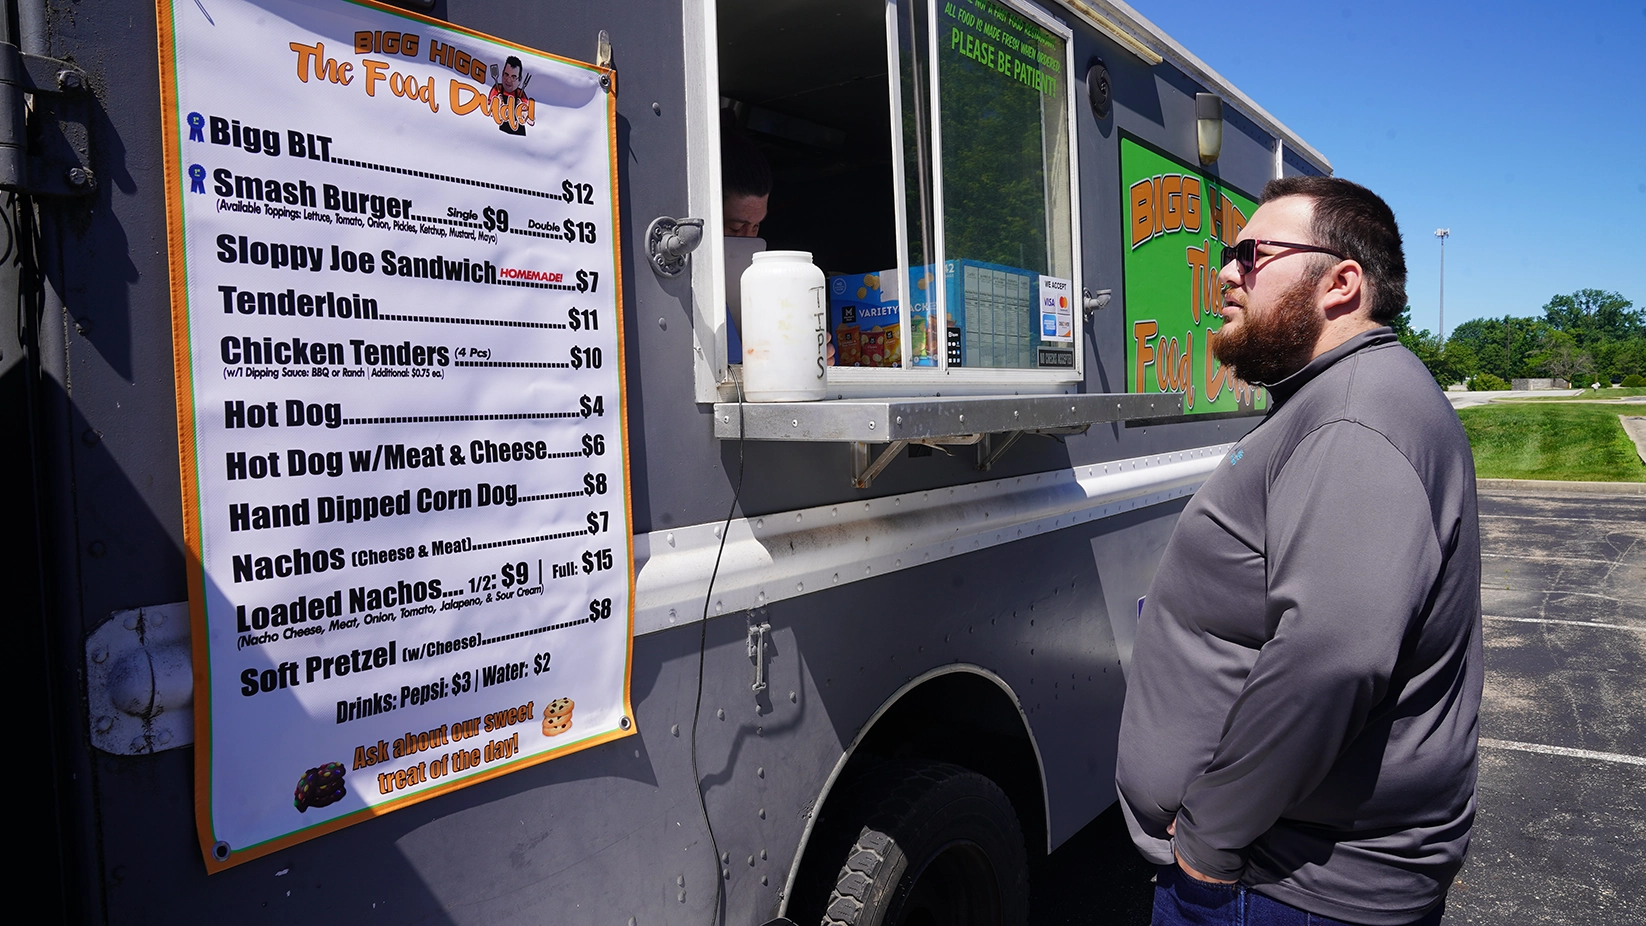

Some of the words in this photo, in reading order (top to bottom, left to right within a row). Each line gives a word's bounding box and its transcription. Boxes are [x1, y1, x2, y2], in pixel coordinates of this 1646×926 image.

[354, 30, 420, 56] BIGG
[430, 39, 487, 84] HIGG
[944, 2, 956, 18] ALL
[958, 8, 975, 27] FOOD
[976, 18, 983, 32] IS
[984, 23, 1002, 42] MADE
[1002, 31, 1020, 52] FRESH
[1020, 42, 1036, 60] WHEN
[289, 42, 354, 86] The
[362, 59, 439, 113] Food
[450, 79, 536, 130] Dude!
[952, 27, 994, 69] PLEASE
[998, 50, 1011, 76] BE
[1014, 59, 1057, 98] PATIENT!
[210, 116, 280, 156] Bigg
[288, 130, 332, 162] BLT
[562, 179, 594, 205] $12
[214, 168, 317, 208] Smash
[323, 183, 412, 220] Burger
[447, 206, 478, 220] Single
[482, 206, 508, 232] $9
[528, 219, 560, 232] Double
[563, 218, 596, 244] $13
[216, 199, 262, 214] (Available
[264, 204, 301, 221] Toppings:
[304, 208, 333, 224] Lettuce,
[335, 213, 364, 228] Tomato,
[367, 218, 391, 232] Onion,
[394, 221, 418, 234] Pickles,
[420, 224, 447, 238] Ketchup,
[450, 227, 476, 241] Mustard,
[478, 230, 498, 245] Mayo)
[1130, 173, 1200, 250] BIGG
[1209, 183, 1247, 247] HI
[216, 234, 323, 272] Sloppy
[330, 245, 374, 274] Joe
[382, 250, 496, 284] Sandwich
[500, 268, 563, 282] HOMEMADE!
[576, 268, 598, 294] $7
[1044, 280, 1051, 288] WE
[218, 285, 378, 320] Tenderloin
[568, 306, 598, 331] $11
[858, 306, 899, 318] VARIETY
[1044, 297, 1055, 307] VISA
[220, 335, 344, 365] Chicken
[350, 340, 450, 366] Tenders
[454, 348, 466, 360] (4
[470, 348, 491, 360] Pcs)
[570, 345, 602, 370] $10
[223, 367, 243, 380] (w/1
[246, 367, 278, 380] Dipping
[282, 368, 309, 378] Sauce:
[312, 368, 329, 378] BBQ
[342, 368, 364, 378] Ranch
[371, 368, 410, 378] Additional:
[412, 368, 430, 378] $0.75
[432, 368, 444, 380] ea.)
[1134, 320, 1195, 410] Food
[224, 400, 279, 428] Hot
[286, 400, 342, 428] Dog
[580, 394, 604, 419] $4
[226, 452, 281, 480] Hot
[287, 450, 343, 477] Dog
[349, 444, 445, 472] w/Meat
[450, 444, 466, 466] &
[470, 440, 547, 464] Cheese
[582, 433, 605, 458] $6
[229, 498, 310, 532] Hand
[317, 490, 410, 524] Dipped
[417, 488, 472, 514] Corn
[478, 483, 517, 506] Dog
[583, 472, 607, 497] $8
[232, 548, 346, 584] Nachos
[352, 546, 414, 567] (Cheese
[418, 544, 428, 558] &
[586, 511, 608, 536] $7
[236, 590, 342, 633] Loaded
[348, 579, 442, 614] Nachos
[468, 573, 496, 593] 1/2:
[501, 561, 528, 589] $9
[552, 562, 578, 579] Full:
[582, 548, 613, 575] $15
[236, 633, 279, 650] (Nacho
[283, 625, 325, 640] Cheese,
[328, 618, 360, 632] Meat,
[364, 612, 397, 626] Onion,
[400, 604, 436, 618] Tomato,
[440, 597, 483, 612] Jalapeno,
[486, 592, 492, 603] &
[496, 590, 514, 602] Sour
[516, 584, 544, 598] Cream)
[240, 661, 300, 697] Soft
[306, 640, 396, 684] Pretzel
[589, 598, 612, 623] $8
[336, 692, 397, 724] Drinks:
[400, 676, 448, 708] Pepsi:
[452, 671, 470, 697] $3
[482, 660, 528, 688] Water:
[534, 652, 551, 676] $2
[353, 738, 389, 771] Ask
[393, 724, 450, 758] about
[452, 715, 481, 742] our
[484, 701, 534, 732] sweet
[378, 764, 426, 794] treat
[430, 755, 450, 780] of
[452, 746, 481, 774] the
[484, 732, 519, 764] day!
